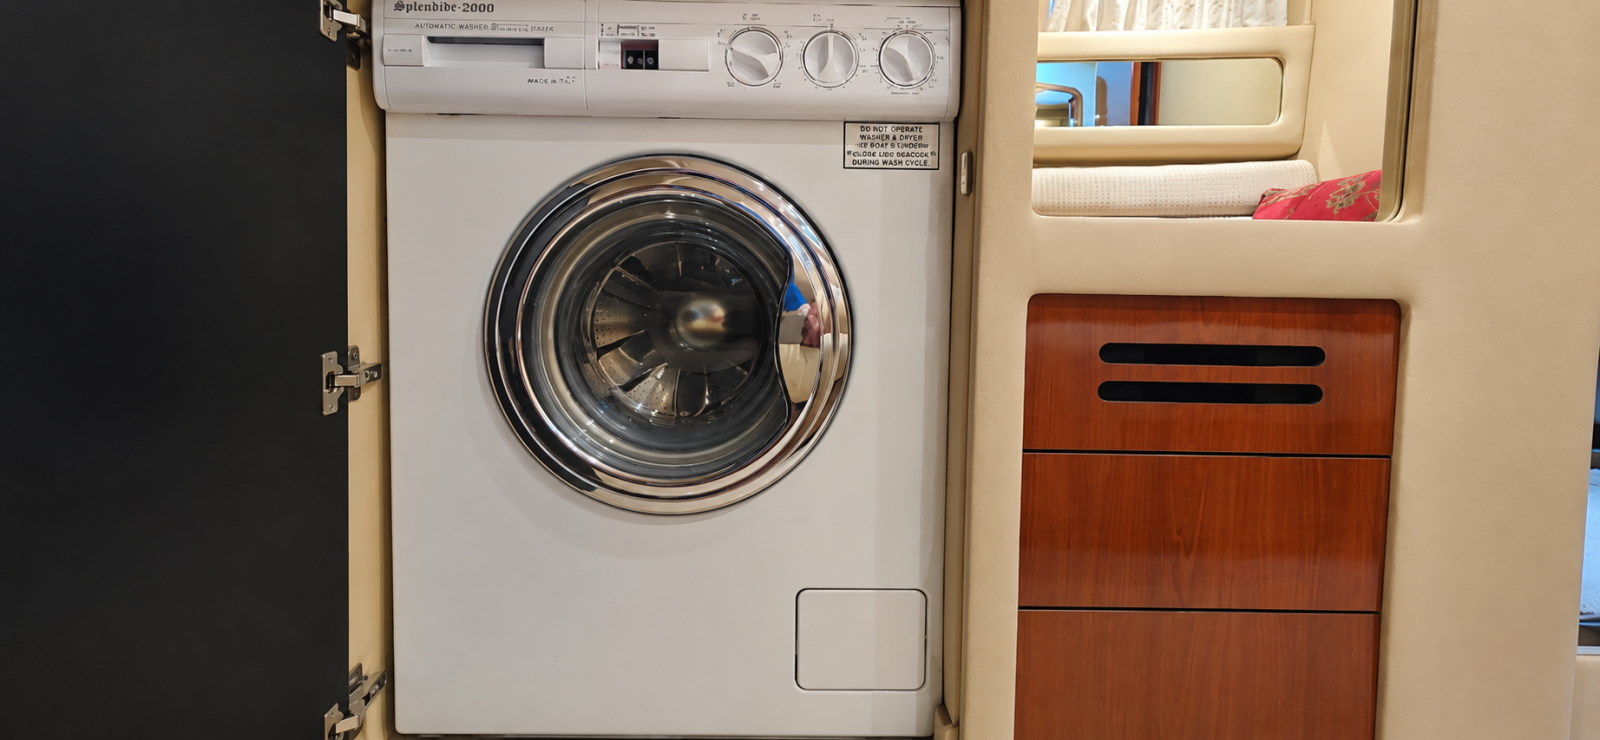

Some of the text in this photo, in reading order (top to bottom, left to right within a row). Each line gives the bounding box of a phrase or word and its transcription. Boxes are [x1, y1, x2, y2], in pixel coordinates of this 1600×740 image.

[394, 1, 494, 13] Splendide-2000
[873, 125, 887, 133] NOT
[890, 125, 923, 133] OPERATE
